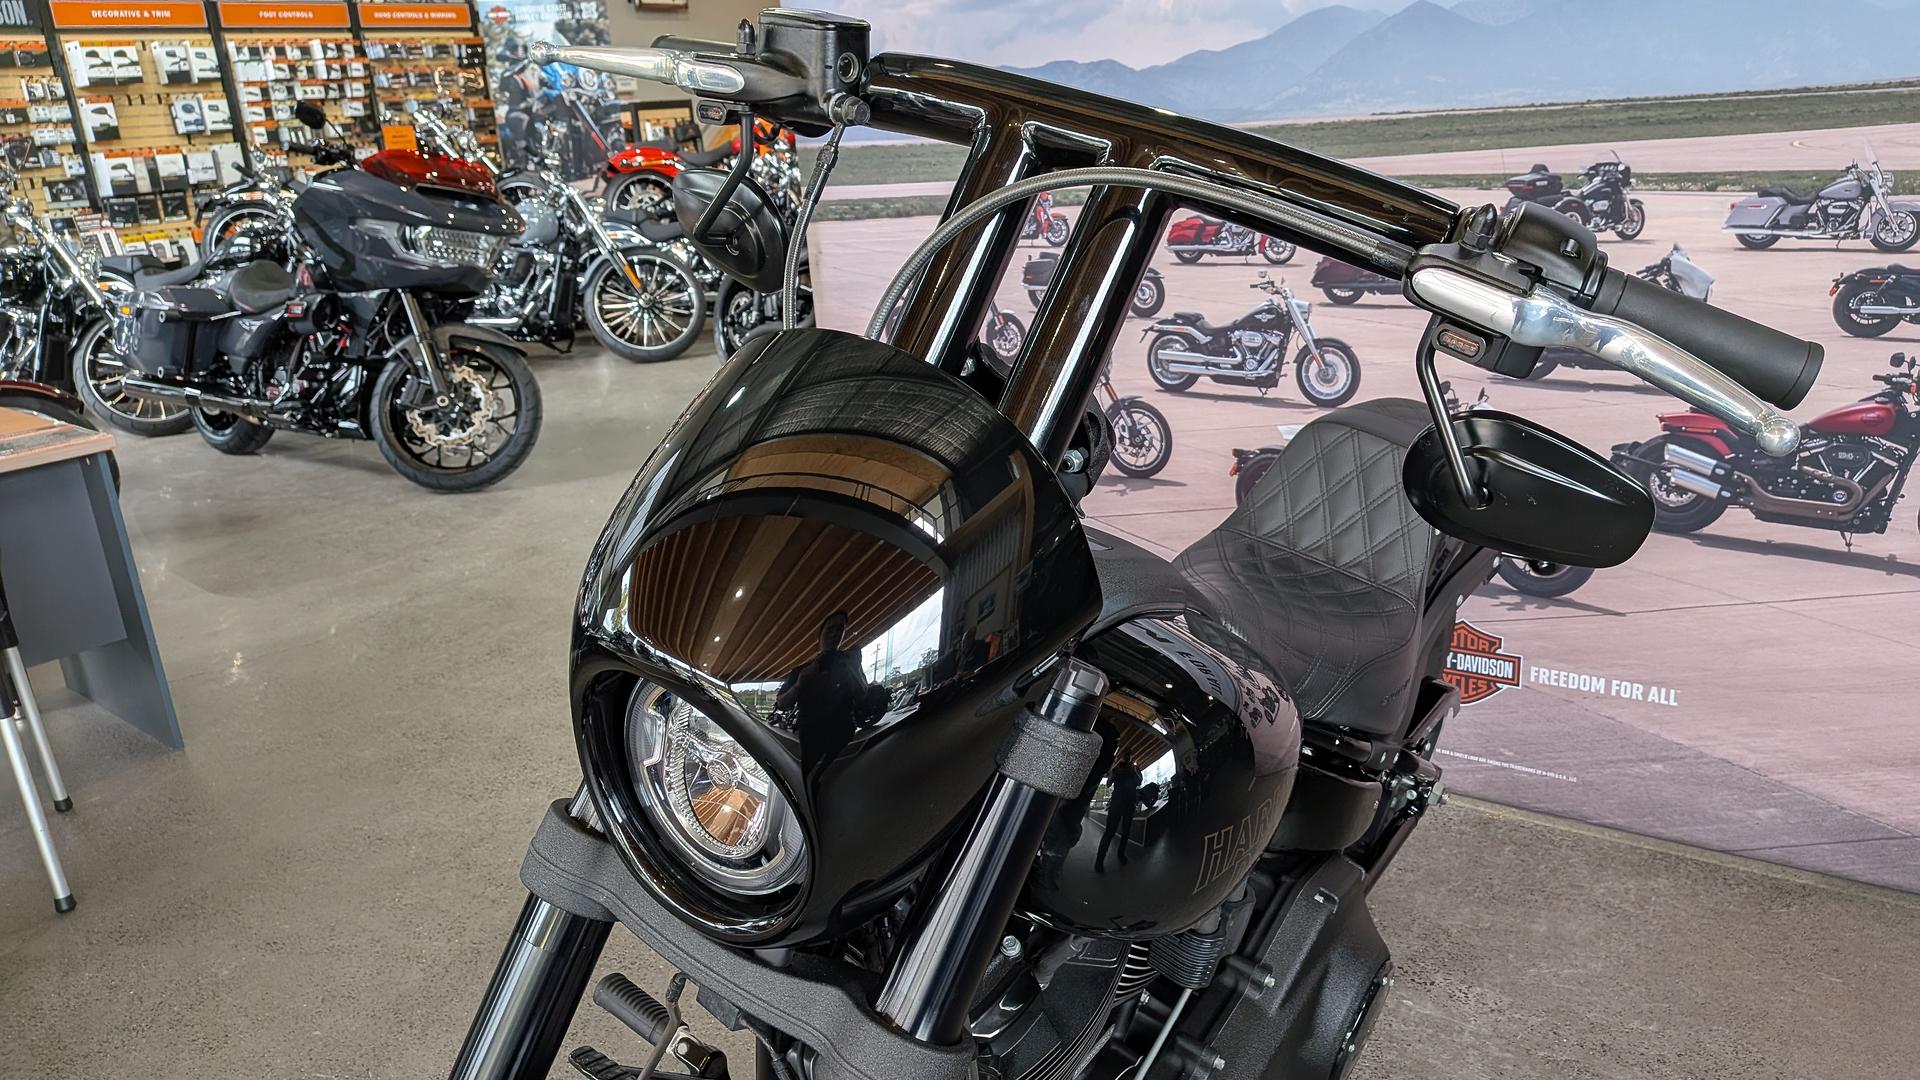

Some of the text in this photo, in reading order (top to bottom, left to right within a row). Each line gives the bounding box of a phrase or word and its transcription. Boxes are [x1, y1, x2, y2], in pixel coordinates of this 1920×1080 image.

[91, 10, 171, 18] DECORATIVE & TRIM
[1530, 665, 1679, 706] FREEDOM FOR ALL
